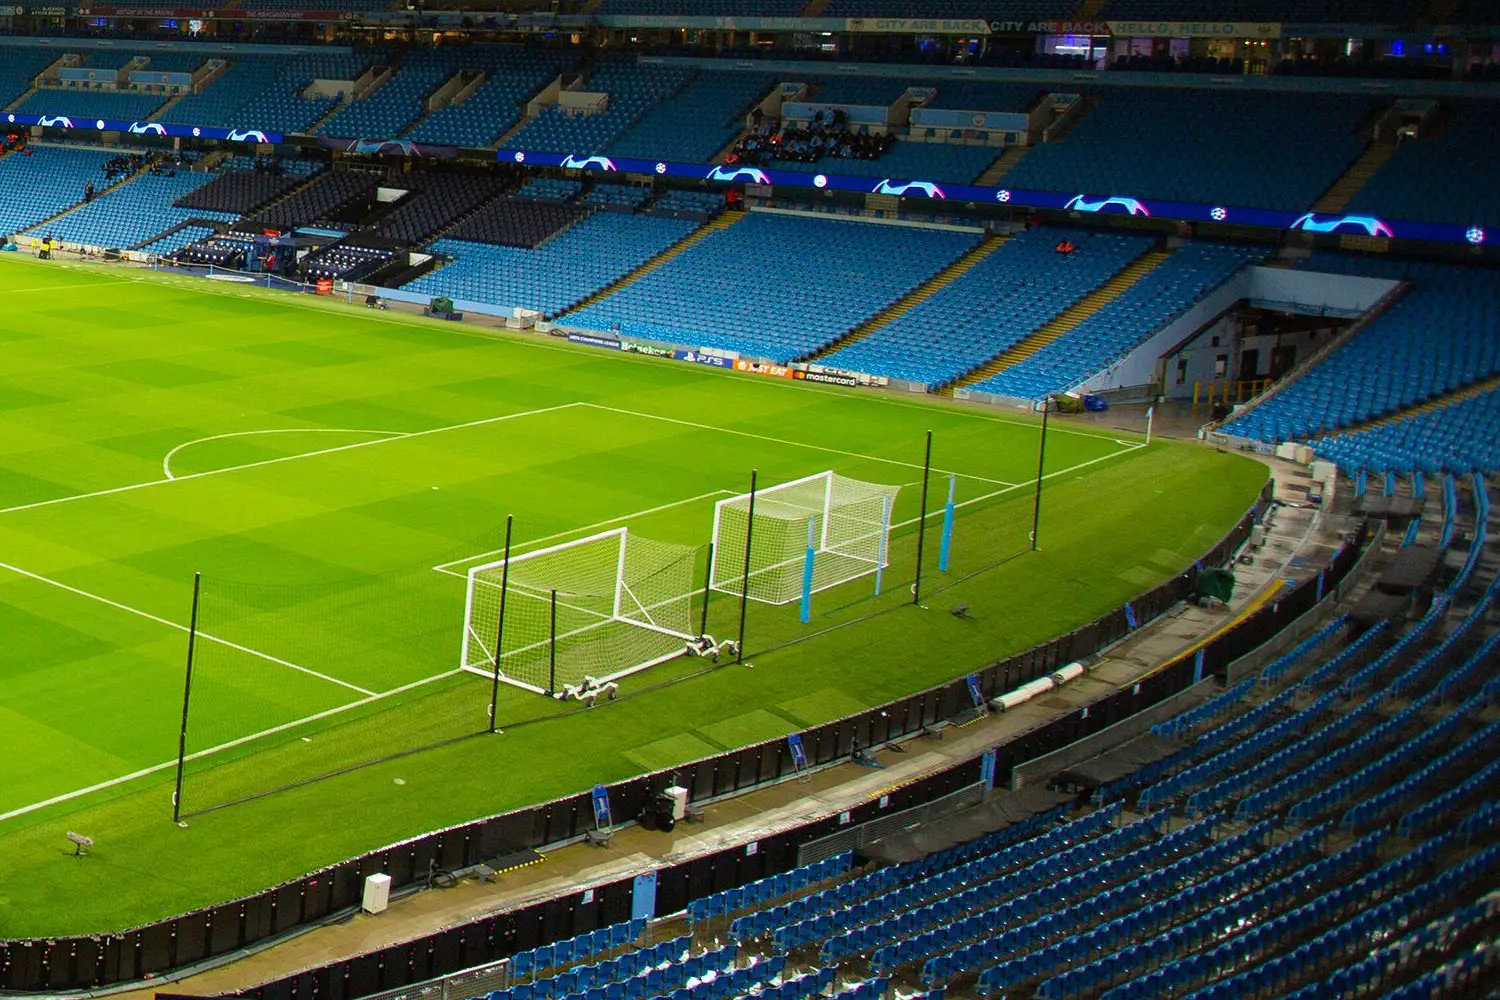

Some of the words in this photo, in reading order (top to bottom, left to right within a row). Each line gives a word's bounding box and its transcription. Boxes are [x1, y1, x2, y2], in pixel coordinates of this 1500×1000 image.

[876, 20, 906, 29] CITY
[911, 20, 937, 30] ARE
[990, 21, 1023, 32] CITY
[1027, 21, 1057, 32] ARE
[621, 341, 668, 356] Heineken
[697, 355, 723, 366] PS5
[770, 367, 787, 377] EAT
[806, 372, 856, 386] mastercard
